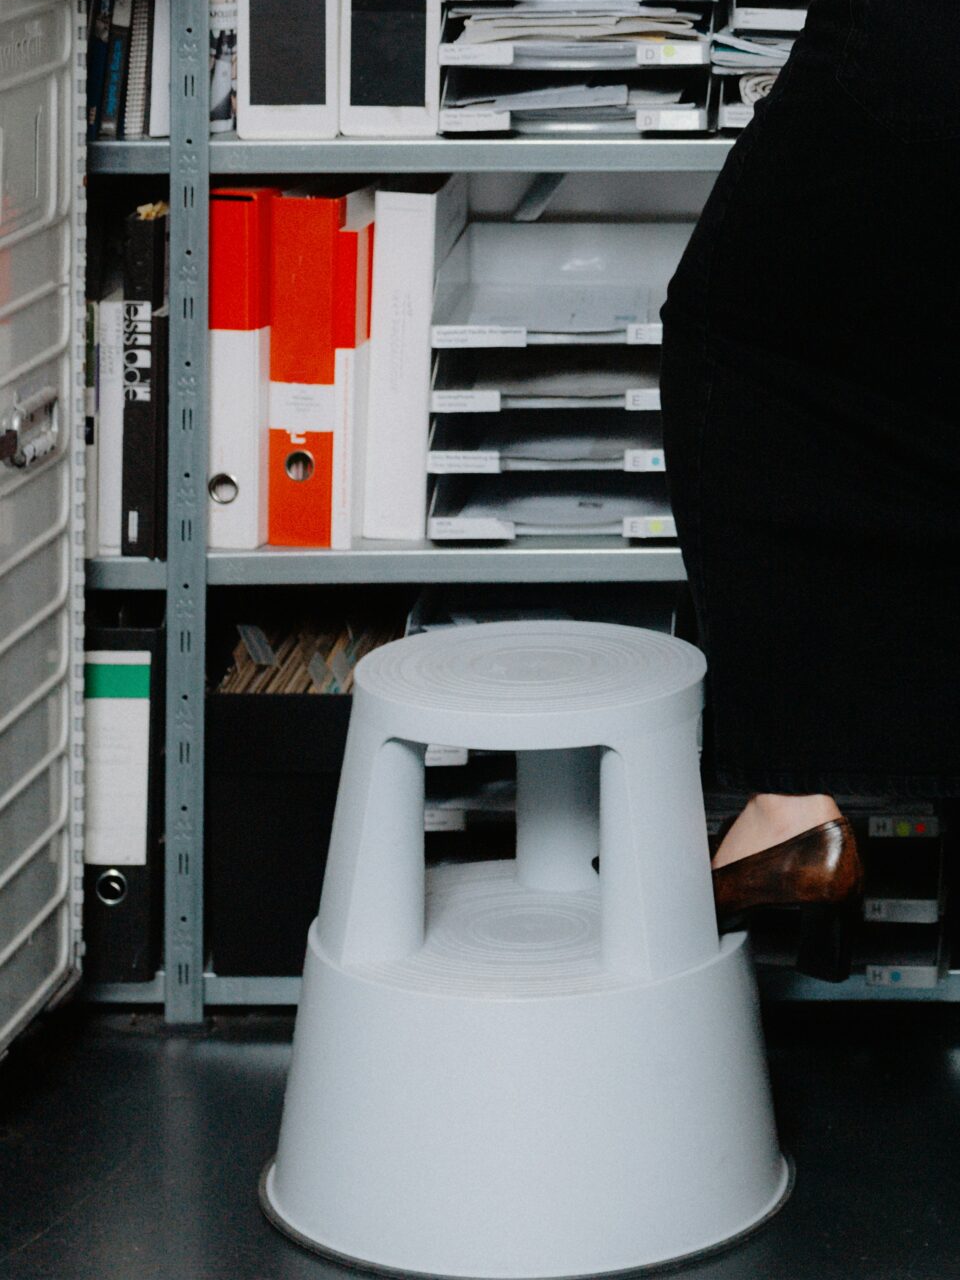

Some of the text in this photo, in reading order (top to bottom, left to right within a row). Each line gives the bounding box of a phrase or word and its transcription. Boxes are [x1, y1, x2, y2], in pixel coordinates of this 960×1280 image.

[645, 48, 655, 60] D
[644, 115, 653, 126] D
[635, 327, 643, 340] E
[632, 394, 640, 406] E
[632, 456, 640, 467] E
[630, 521, 637, 533] E
